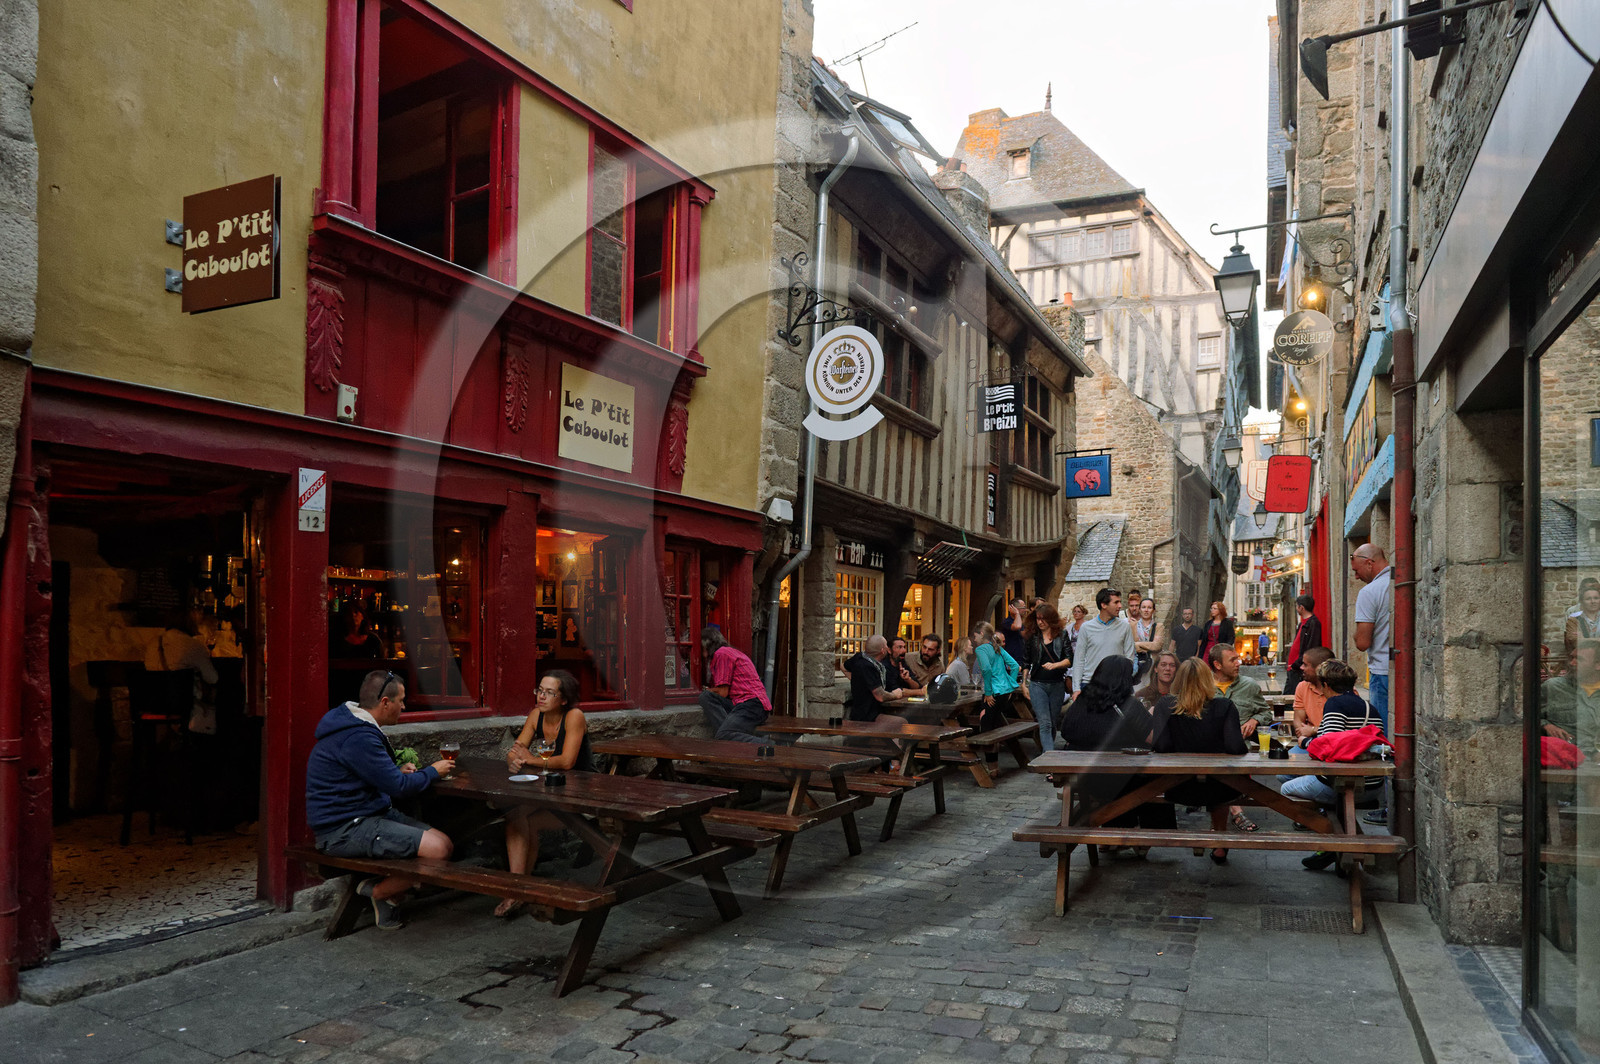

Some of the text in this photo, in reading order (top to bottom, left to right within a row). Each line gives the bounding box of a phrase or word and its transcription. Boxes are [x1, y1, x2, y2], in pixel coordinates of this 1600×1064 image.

[185, 209, 272, 250] Le P'tit
[184, 244, 270, 281] Caboulot
[1276, 330, 1332, 346] COREFF
[823, 355, 832, 368] EINE
[857, 352, 865, 374] BIEREN
[822, 370, 834, 392] KÖNIGIN
[853, 376, 862, 387] DEN
[564, 390, 630, 426] Le P'tit
[986, 406, 994, 415] Le
[563, 415, 628, 448] Caboulot
[301, 476, 324, 504] LICENCE
[306, 515, 320, 528] 12
